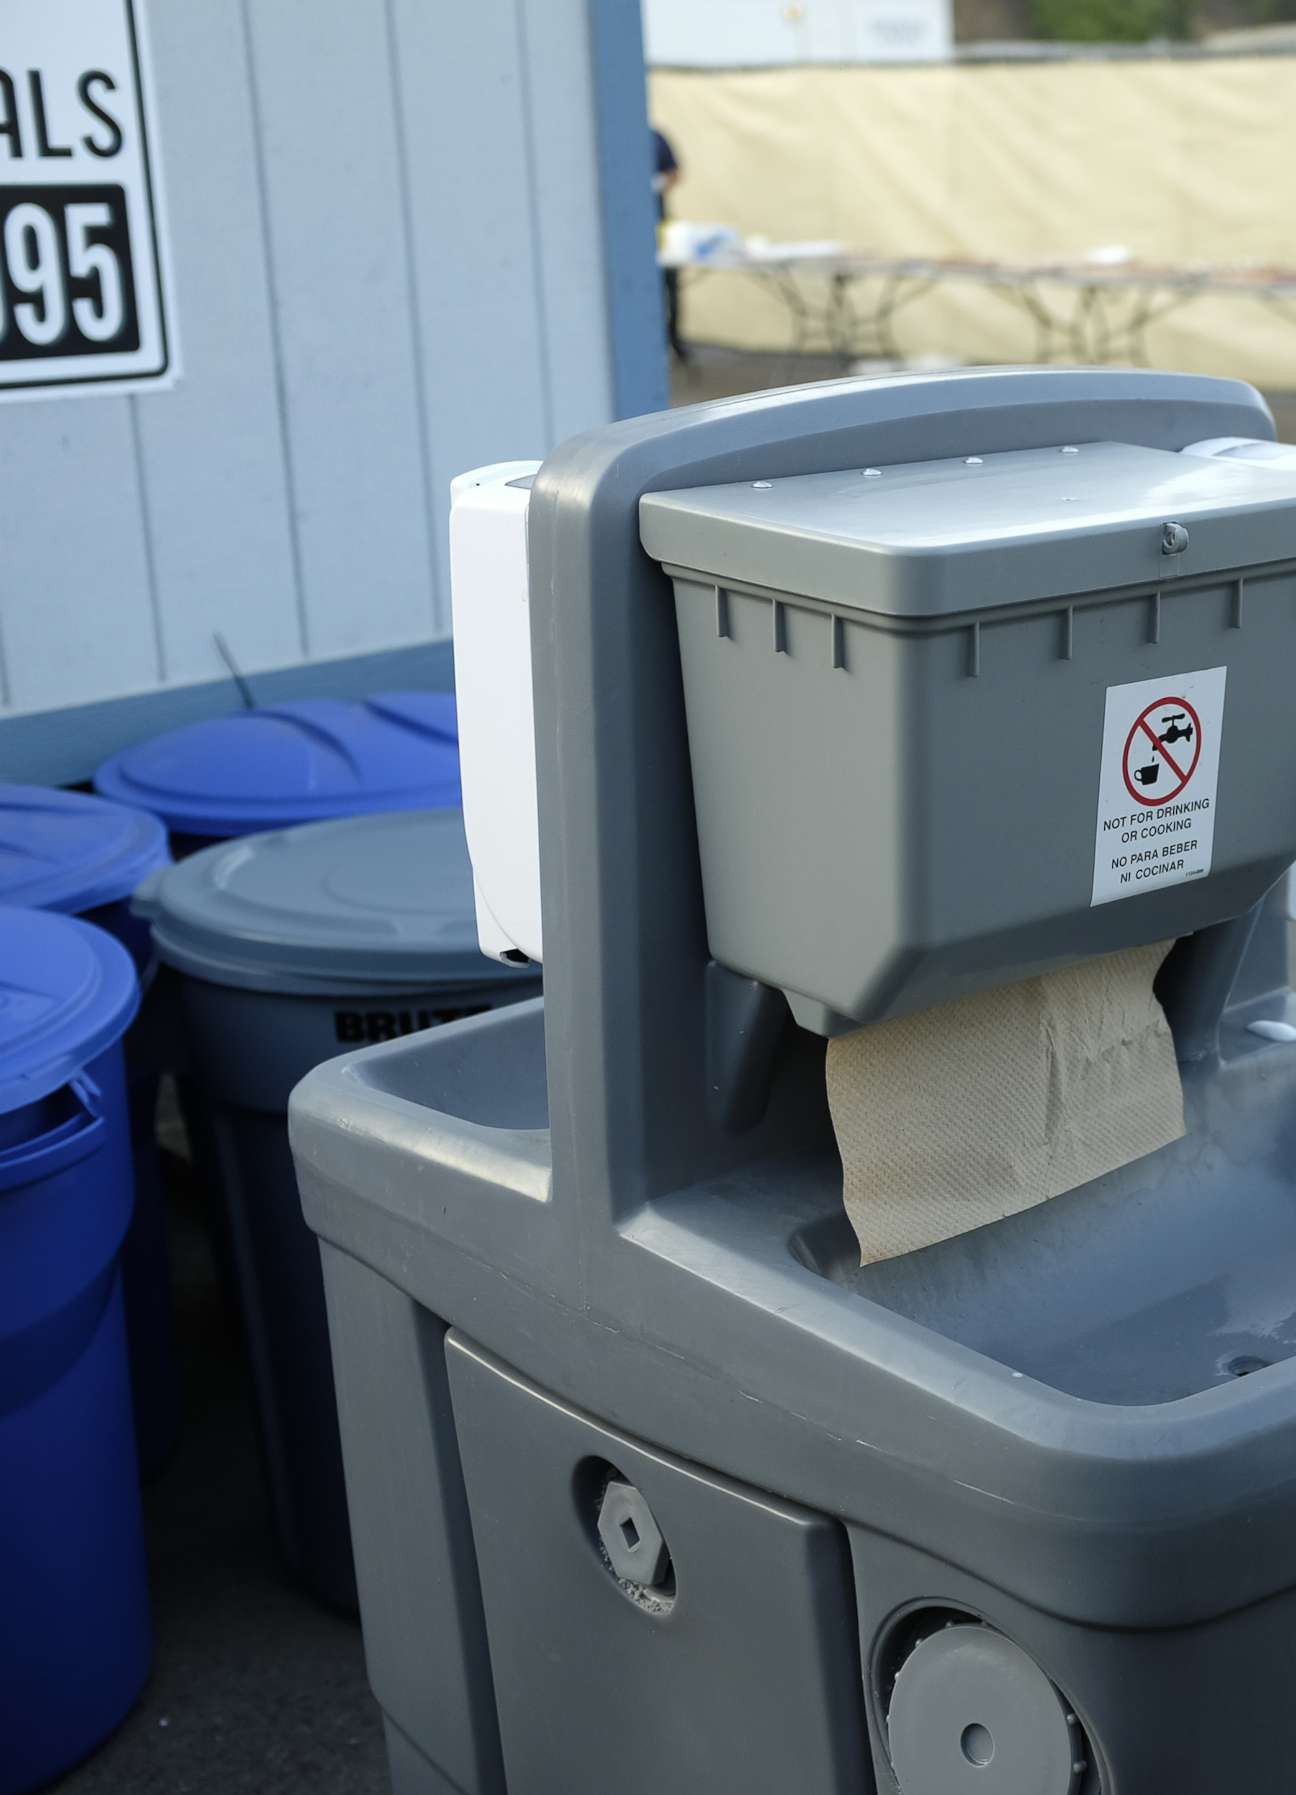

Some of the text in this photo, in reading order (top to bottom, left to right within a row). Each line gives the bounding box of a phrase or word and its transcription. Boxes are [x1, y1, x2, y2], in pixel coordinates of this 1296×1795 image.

[0, 202, 124, 345] 95
[1103, 798, 1210, 831] NOT FOR DRINKING
[1121, 818, 1192, 843] OR COOKING
[1111, 840, 1198, 869] NO PARA BEBER
[1120, 872, 1131, 883] NI
[1135, 859, 1184, 880] COCINAR
[335, 1004, 493, 1043] BRUT
